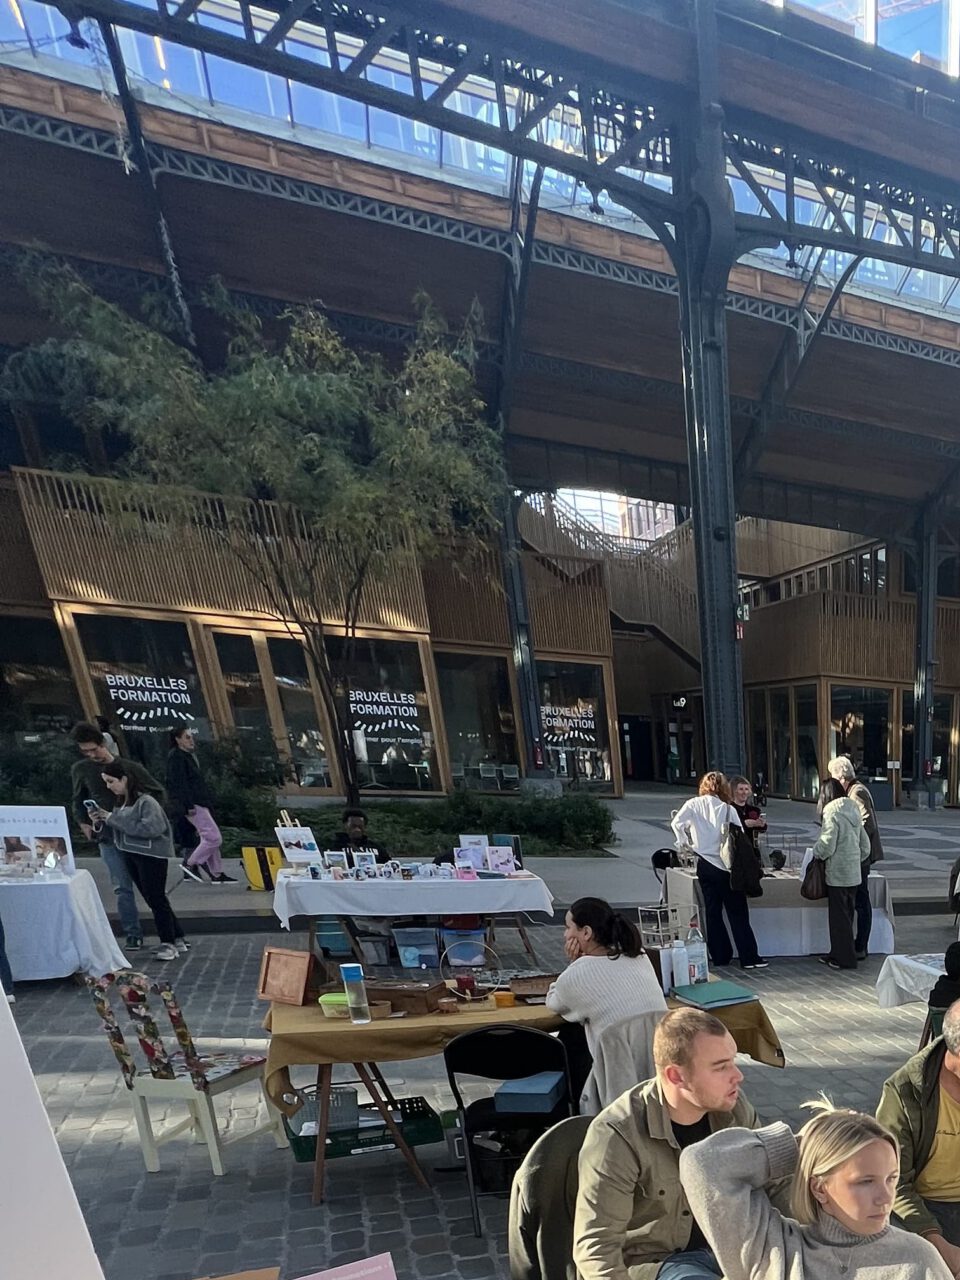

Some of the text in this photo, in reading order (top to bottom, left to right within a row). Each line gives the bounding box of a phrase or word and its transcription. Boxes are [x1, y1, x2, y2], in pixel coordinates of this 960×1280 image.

[105, 674, 188, 690] BRUXELLES
[110, 689, 191, 705] FORMATION
[349, 690, 416, 704] BRUXELLES
[349, 703, 418, 717] FORMATION
[540, 706, 594, 718] BRUXELLES
[545, 717, 595, 729] ORMATION
